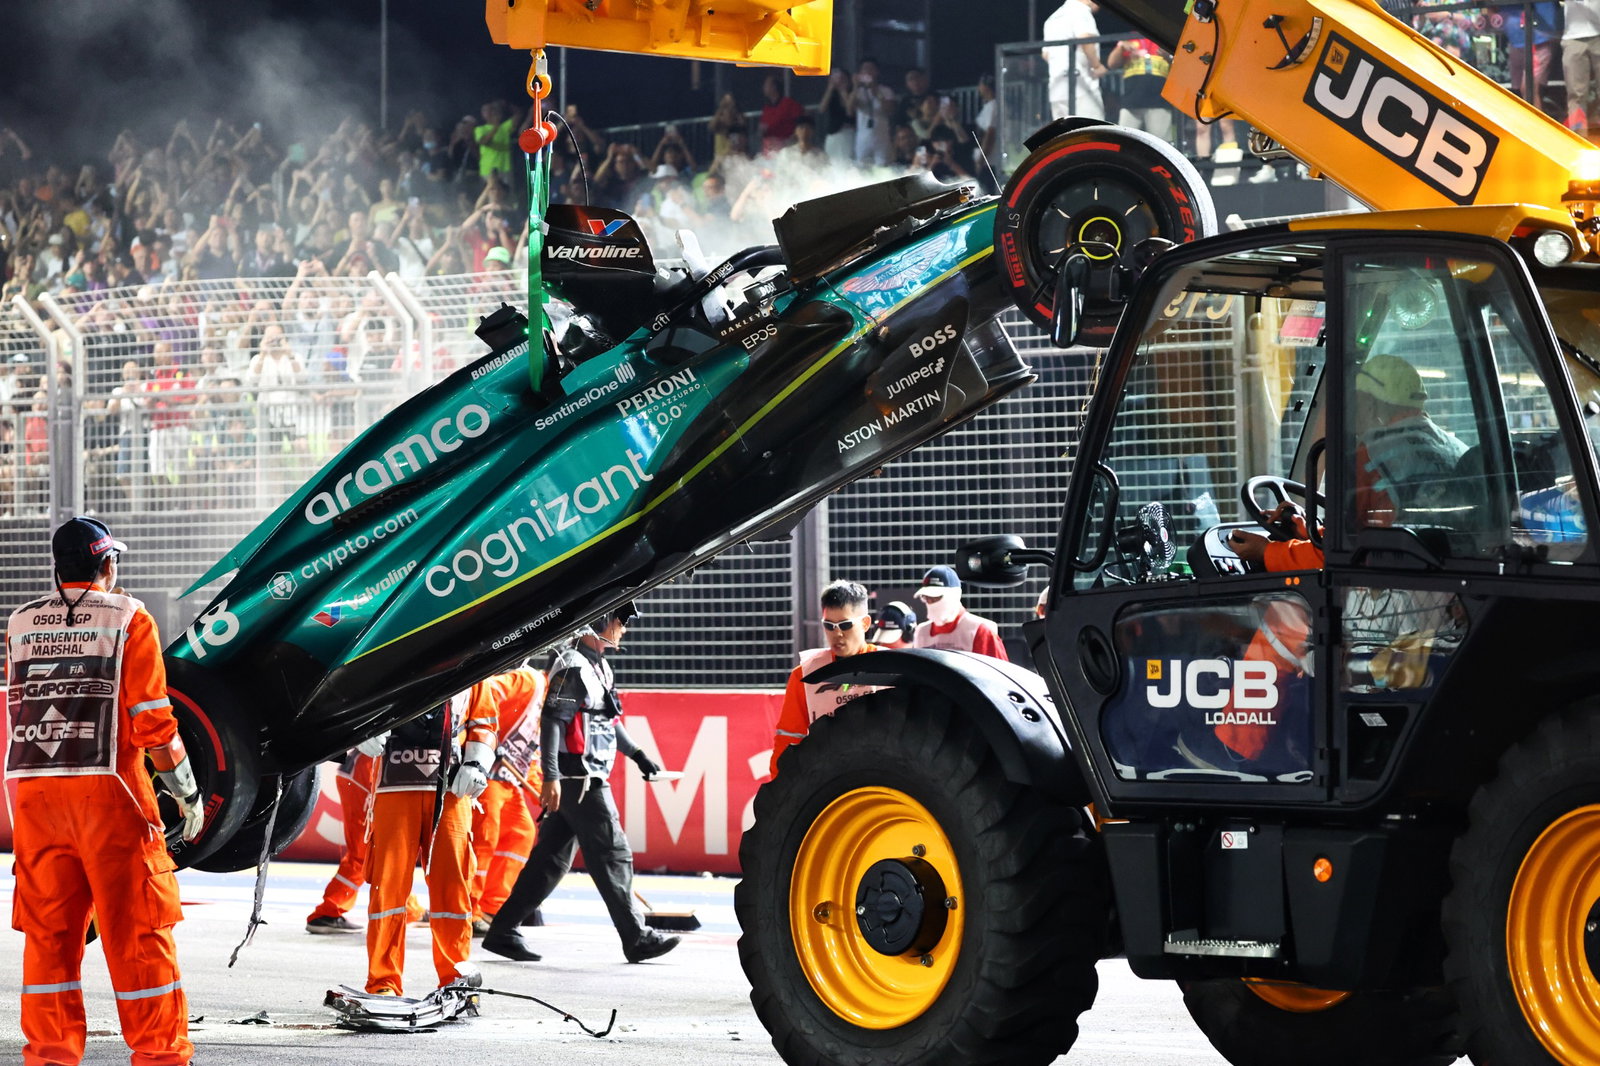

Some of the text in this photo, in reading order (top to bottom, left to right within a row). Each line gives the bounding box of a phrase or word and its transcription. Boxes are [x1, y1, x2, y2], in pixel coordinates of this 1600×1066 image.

[1314, 58, 1487, 197] JCB
[1169, 186, 1196, 244] ZER
[547, 244, 643, 260] Valvoline
[652, 312, 671, 332] citi
[720, 312, 761, 337] OAKLEY
[742, 323, 778, 350] EPOS
[908, 324, 957, 359] BOSS
[471, 341, 531, 381] BOMBARDI
[534, 379, 618, 431] SentinelOne
[616, 367, 697, 418] PERONI
[661, 383, 701, 408] AZZURRO
[837, 390, 941, 455] ASTON MARTIN
[304, 403, 491, 525] aramco
[301, 506, 419, 581] crypto.com
[425, 447, 655, 598] cognizant
[348, 559, 418, 612] Valvoline
[21, 631, 98, 646] INTERVENTION
[31, 644, 84, 656] MARSHAL
[186, 598, 240, 660] 18
[491, 607, 562, 651] GLOBE-TROTTER
[1146, 659, 1279, 710] JCB
[13, 721, 96, 743] COURSE
[1205, 712, 1277, 725] LOADALL
